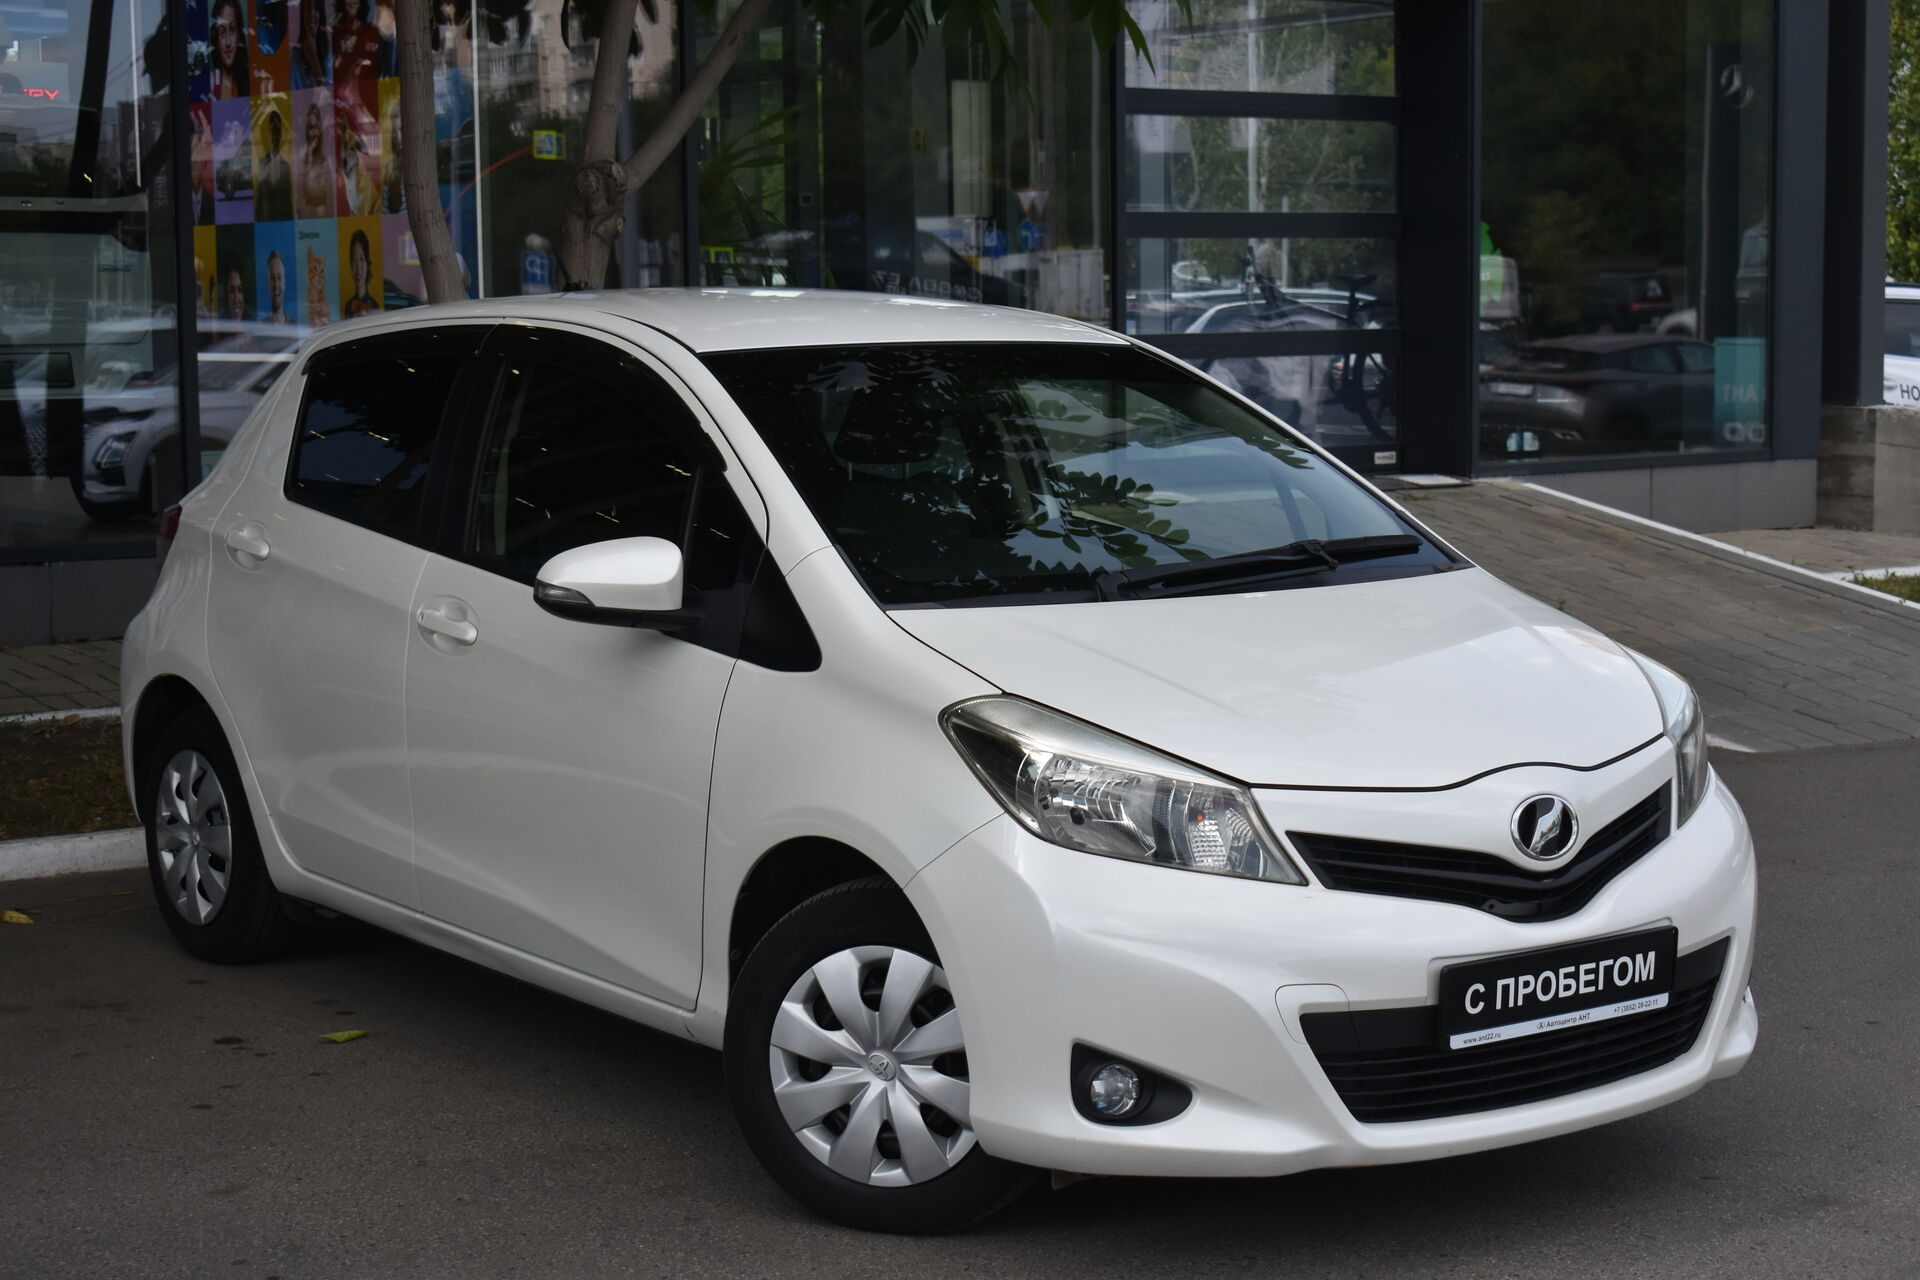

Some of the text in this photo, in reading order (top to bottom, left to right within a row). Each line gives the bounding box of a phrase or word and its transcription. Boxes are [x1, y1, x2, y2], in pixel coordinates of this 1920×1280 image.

[1464, 951, 1656, 1015] С ПРОБЕГОМ
[1546, 1012, 1591, 1028] Автоцентр АНТ
[1462, 1031, 1502, 1045] www.ant22.ru
